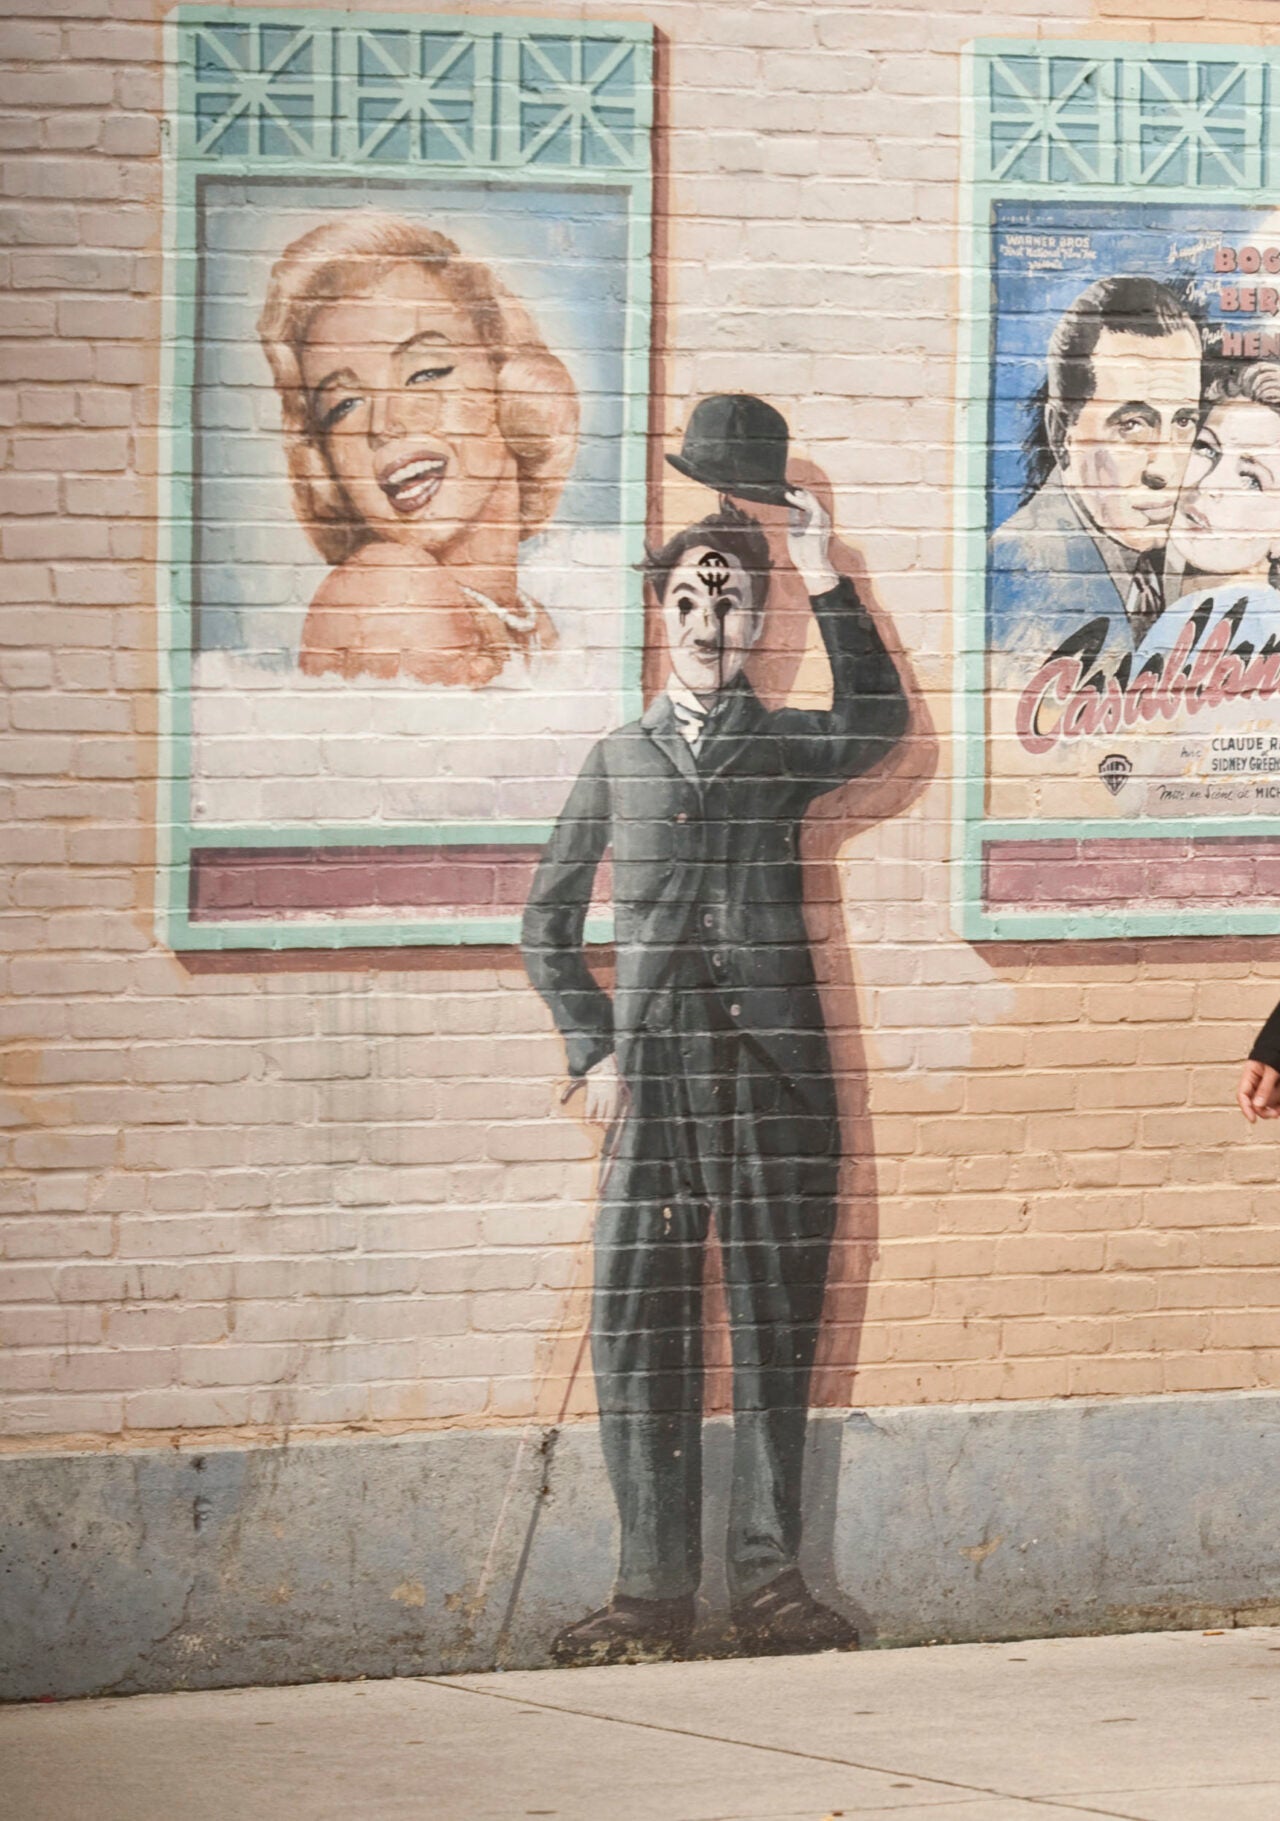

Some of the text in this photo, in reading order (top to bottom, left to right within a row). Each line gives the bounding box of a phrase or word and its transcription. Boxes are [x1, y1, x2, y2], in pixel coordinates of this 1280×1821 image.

[1006, 234, 1089, 249] WARNER BROS
[1211, 737, 1264, 751] CLAUDE
[1211, 757, 1247, 771] SIDNEY
